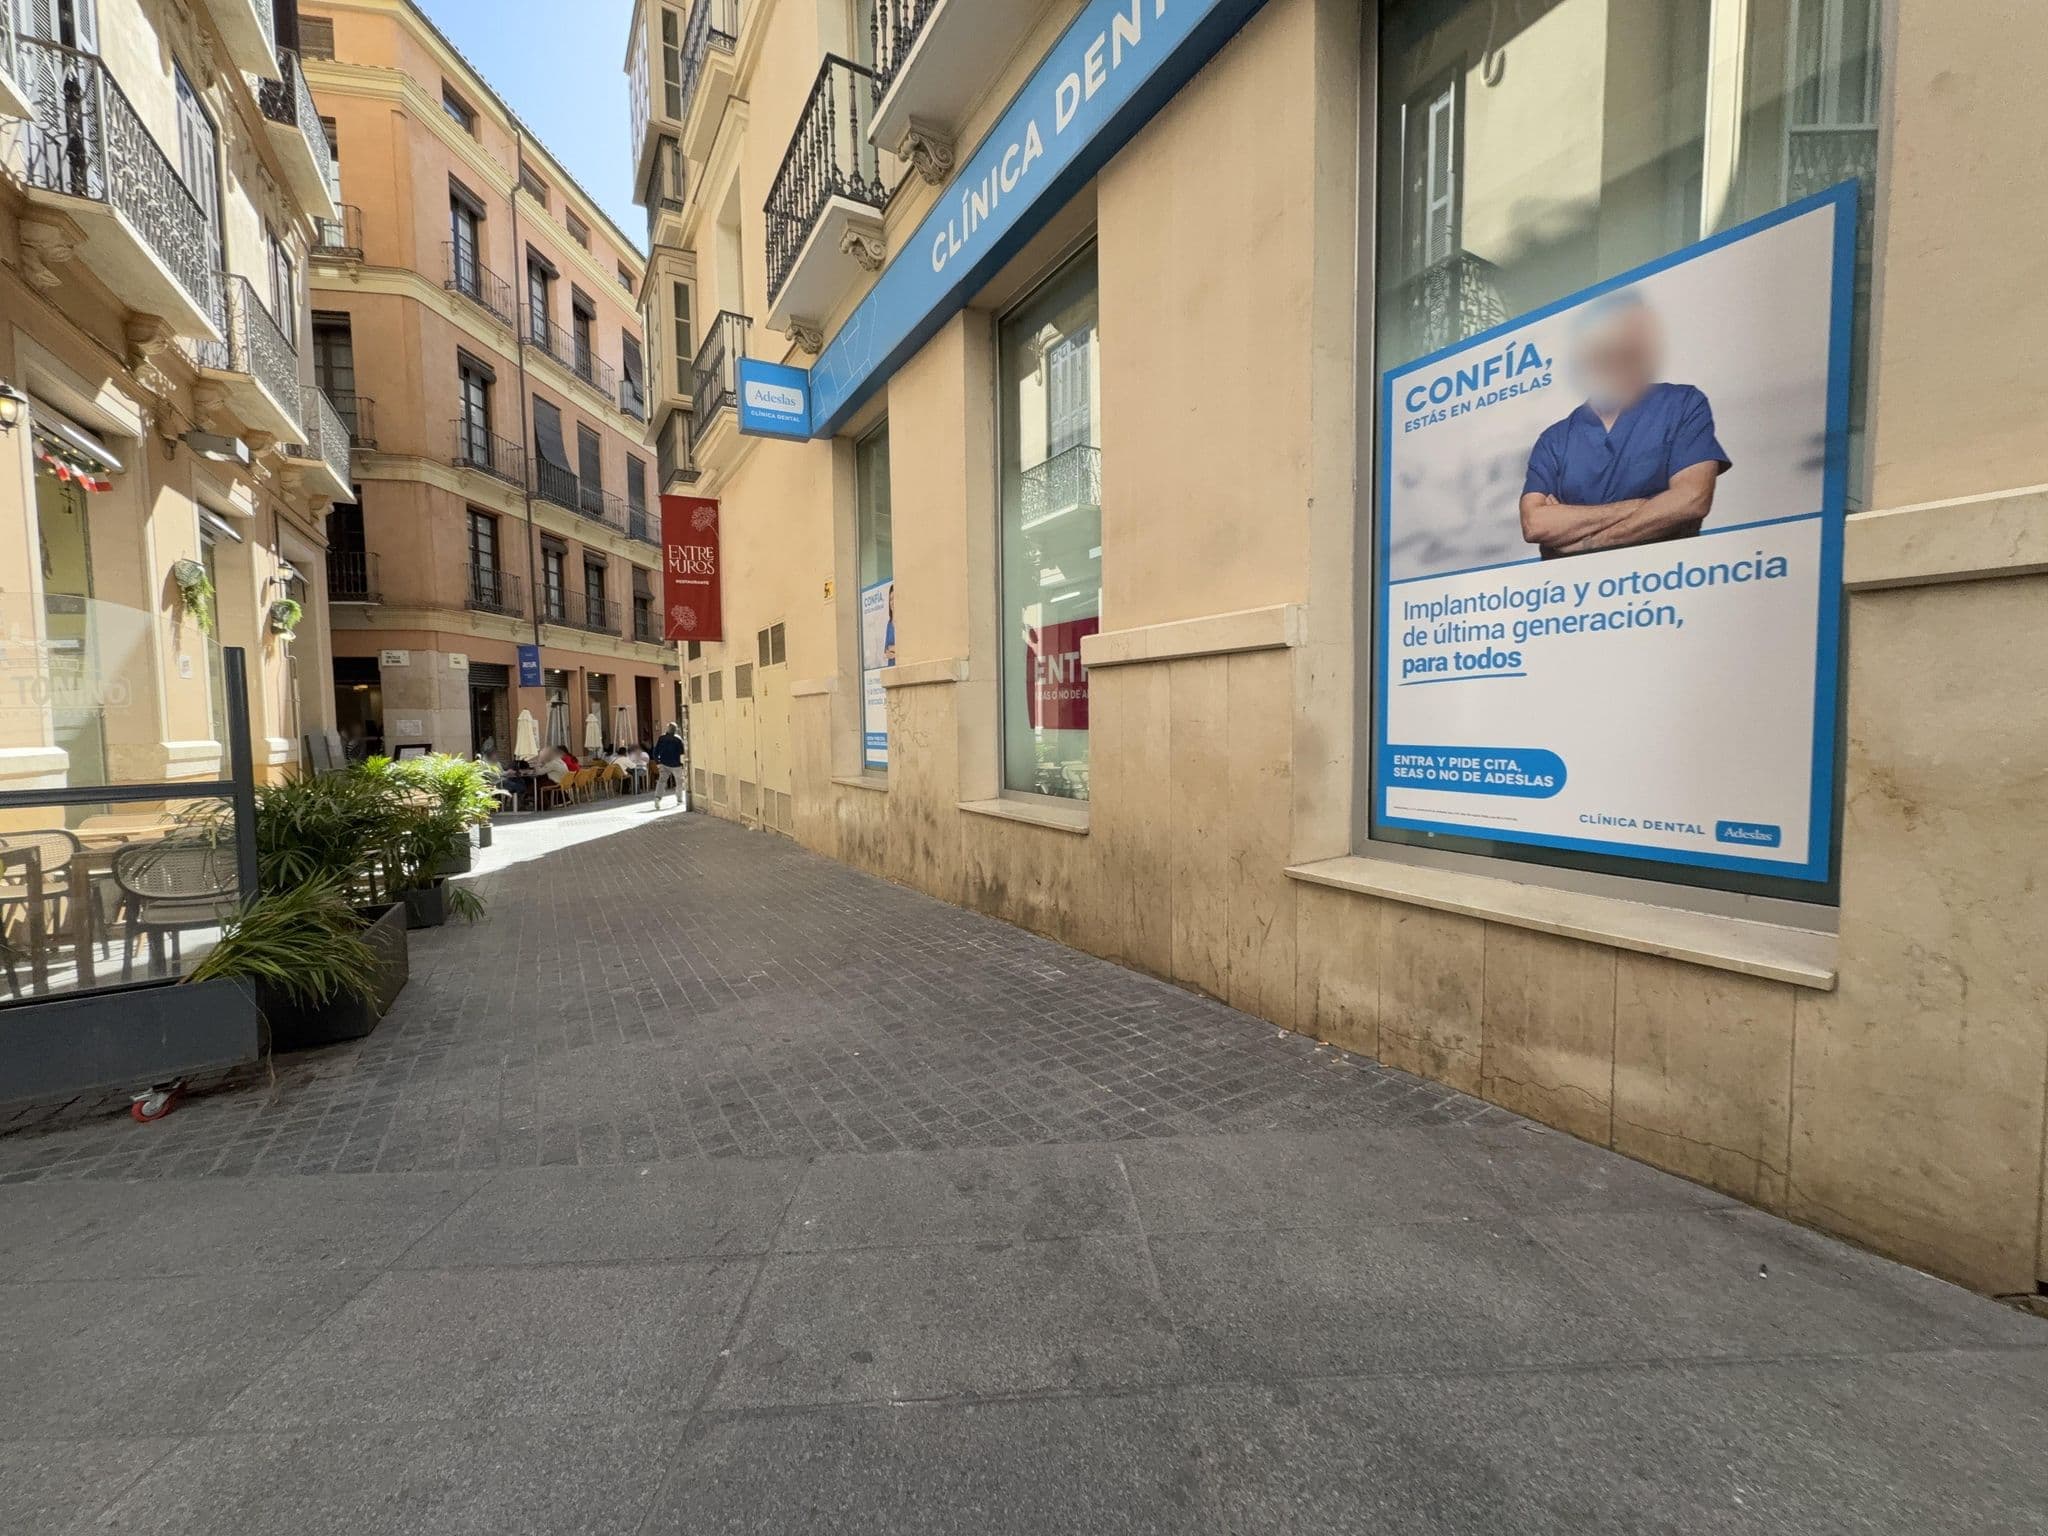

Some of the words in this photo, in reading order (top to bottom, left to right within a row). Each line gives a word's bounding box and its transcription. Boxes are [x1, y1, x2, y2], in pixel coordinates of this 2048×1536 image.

[932, 120, 1044, 272] CLÍNICA
[1405, 340, 1552, 413] CONFÍA,
[754, 389, 796, 406] Adeslas
[1404, 409, 1447, 433] ESTÁS
[1450, 400, 1471, 418] EN
[1475, 373, 1552, 410] ADESLAS
[777, 414, 800, 423] DENTAL
[668, 544, 714, 561] ENTRE
[669, 559, 715, 575] MUROS
[1404, 580, 1565, 622] Implantología
[1573, 582, 1590, 607] y
[1598, 551, 1788, 598] ortodoncia
[1403, 625, 1427, 647] de
[1433, 619, 1505, 644] última
[1512, 600, 1684, 644] generación,
[1402, 655, 1448, 678] para
[1453, 646, 1522, 671] todos
[1393, 754, 1434, 767] ENTRA
[1436, 756, 1446, 767] Y
[1449, 757, 1481, 769] PIDE
[1483, 758, 1522, 772] CITA,
[1393, 767, 1424, 778] SEAS
[1426, 769, 1436, 780] O
[1439, 770, 1459, 781] NO
[1462, 771, 1481, 783] DE
[1484, 772, 1554, 788] ADESLAS
[1579, 813, 1637, 828] CLÍNICA
[1643, 819, 1706, 835] DENTAL
[1724, 827, 1773, 842] Adeslas
